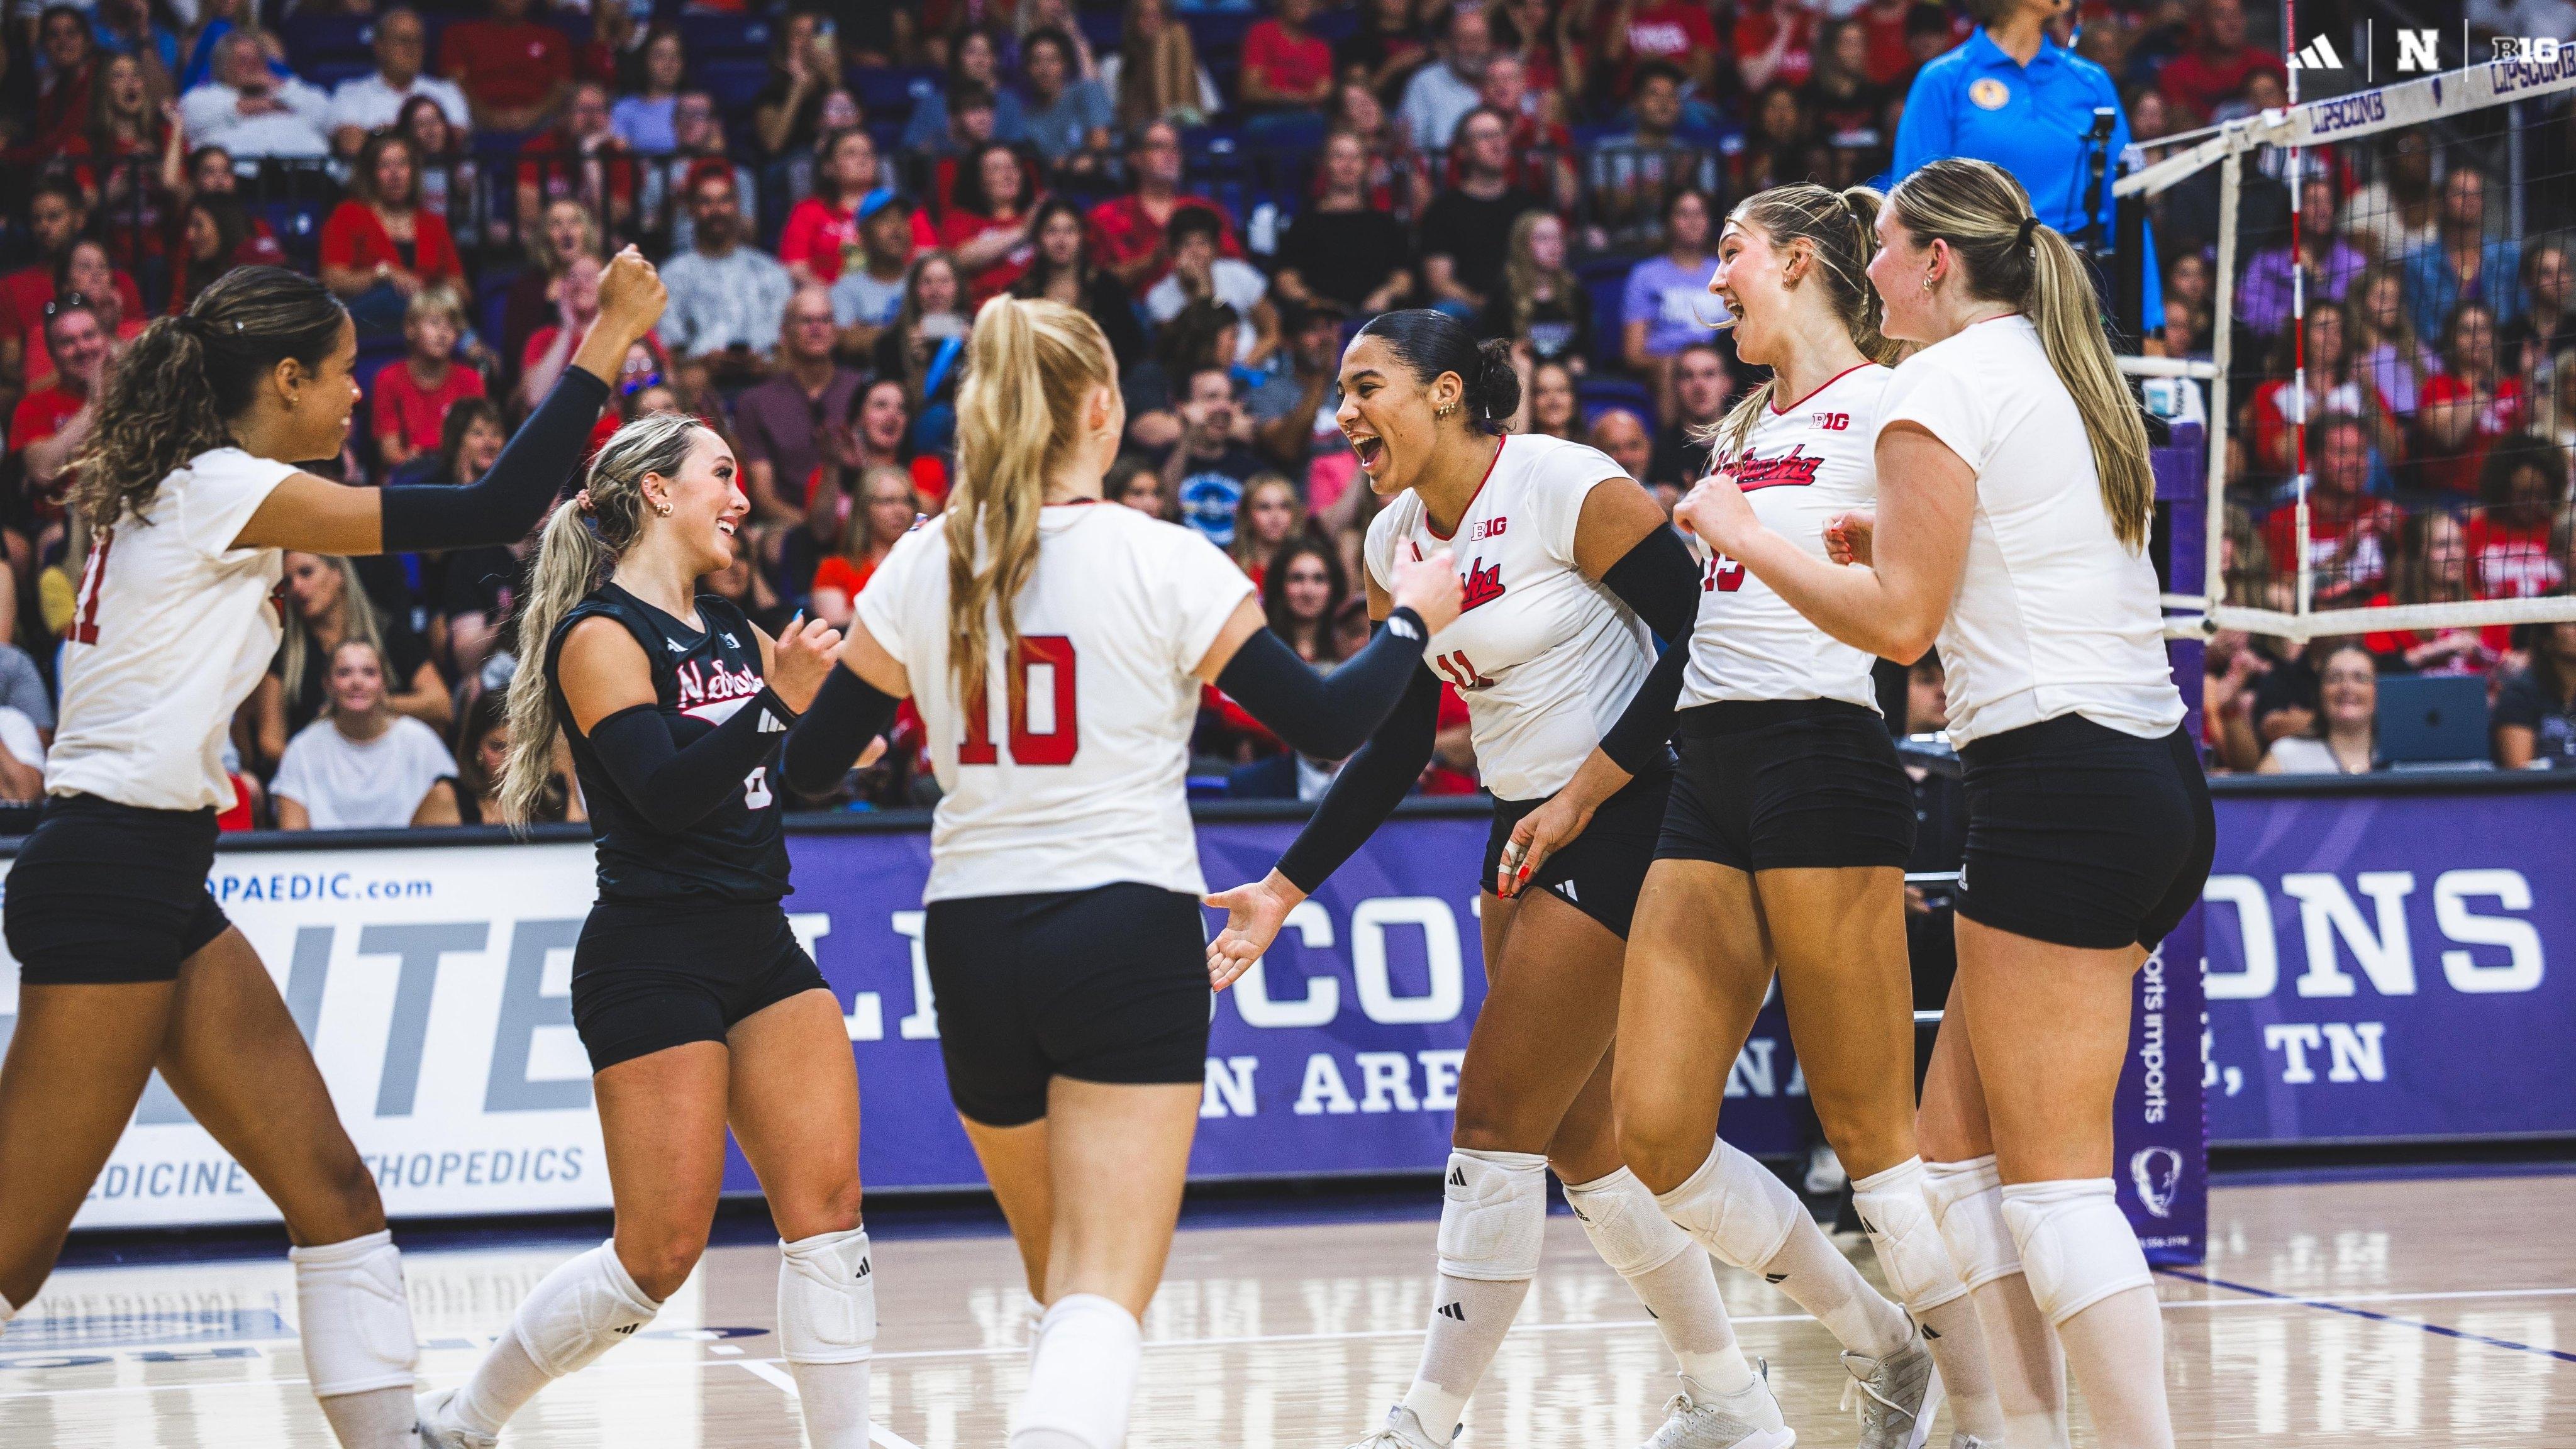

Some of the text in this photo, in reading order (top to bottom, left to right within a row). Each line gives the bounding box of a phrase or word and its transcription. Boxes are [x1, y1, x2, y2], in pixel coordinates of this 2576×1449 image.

[2490, 44, 2576, 95] LIPSCOMB
[2308, 91, 2385, 135] LIPSCOMB
[958, 634, 1078, 767] 10
[2265, 1022, 2385, 1084] TN
[88, 1160, 245, 1200] DICINE
